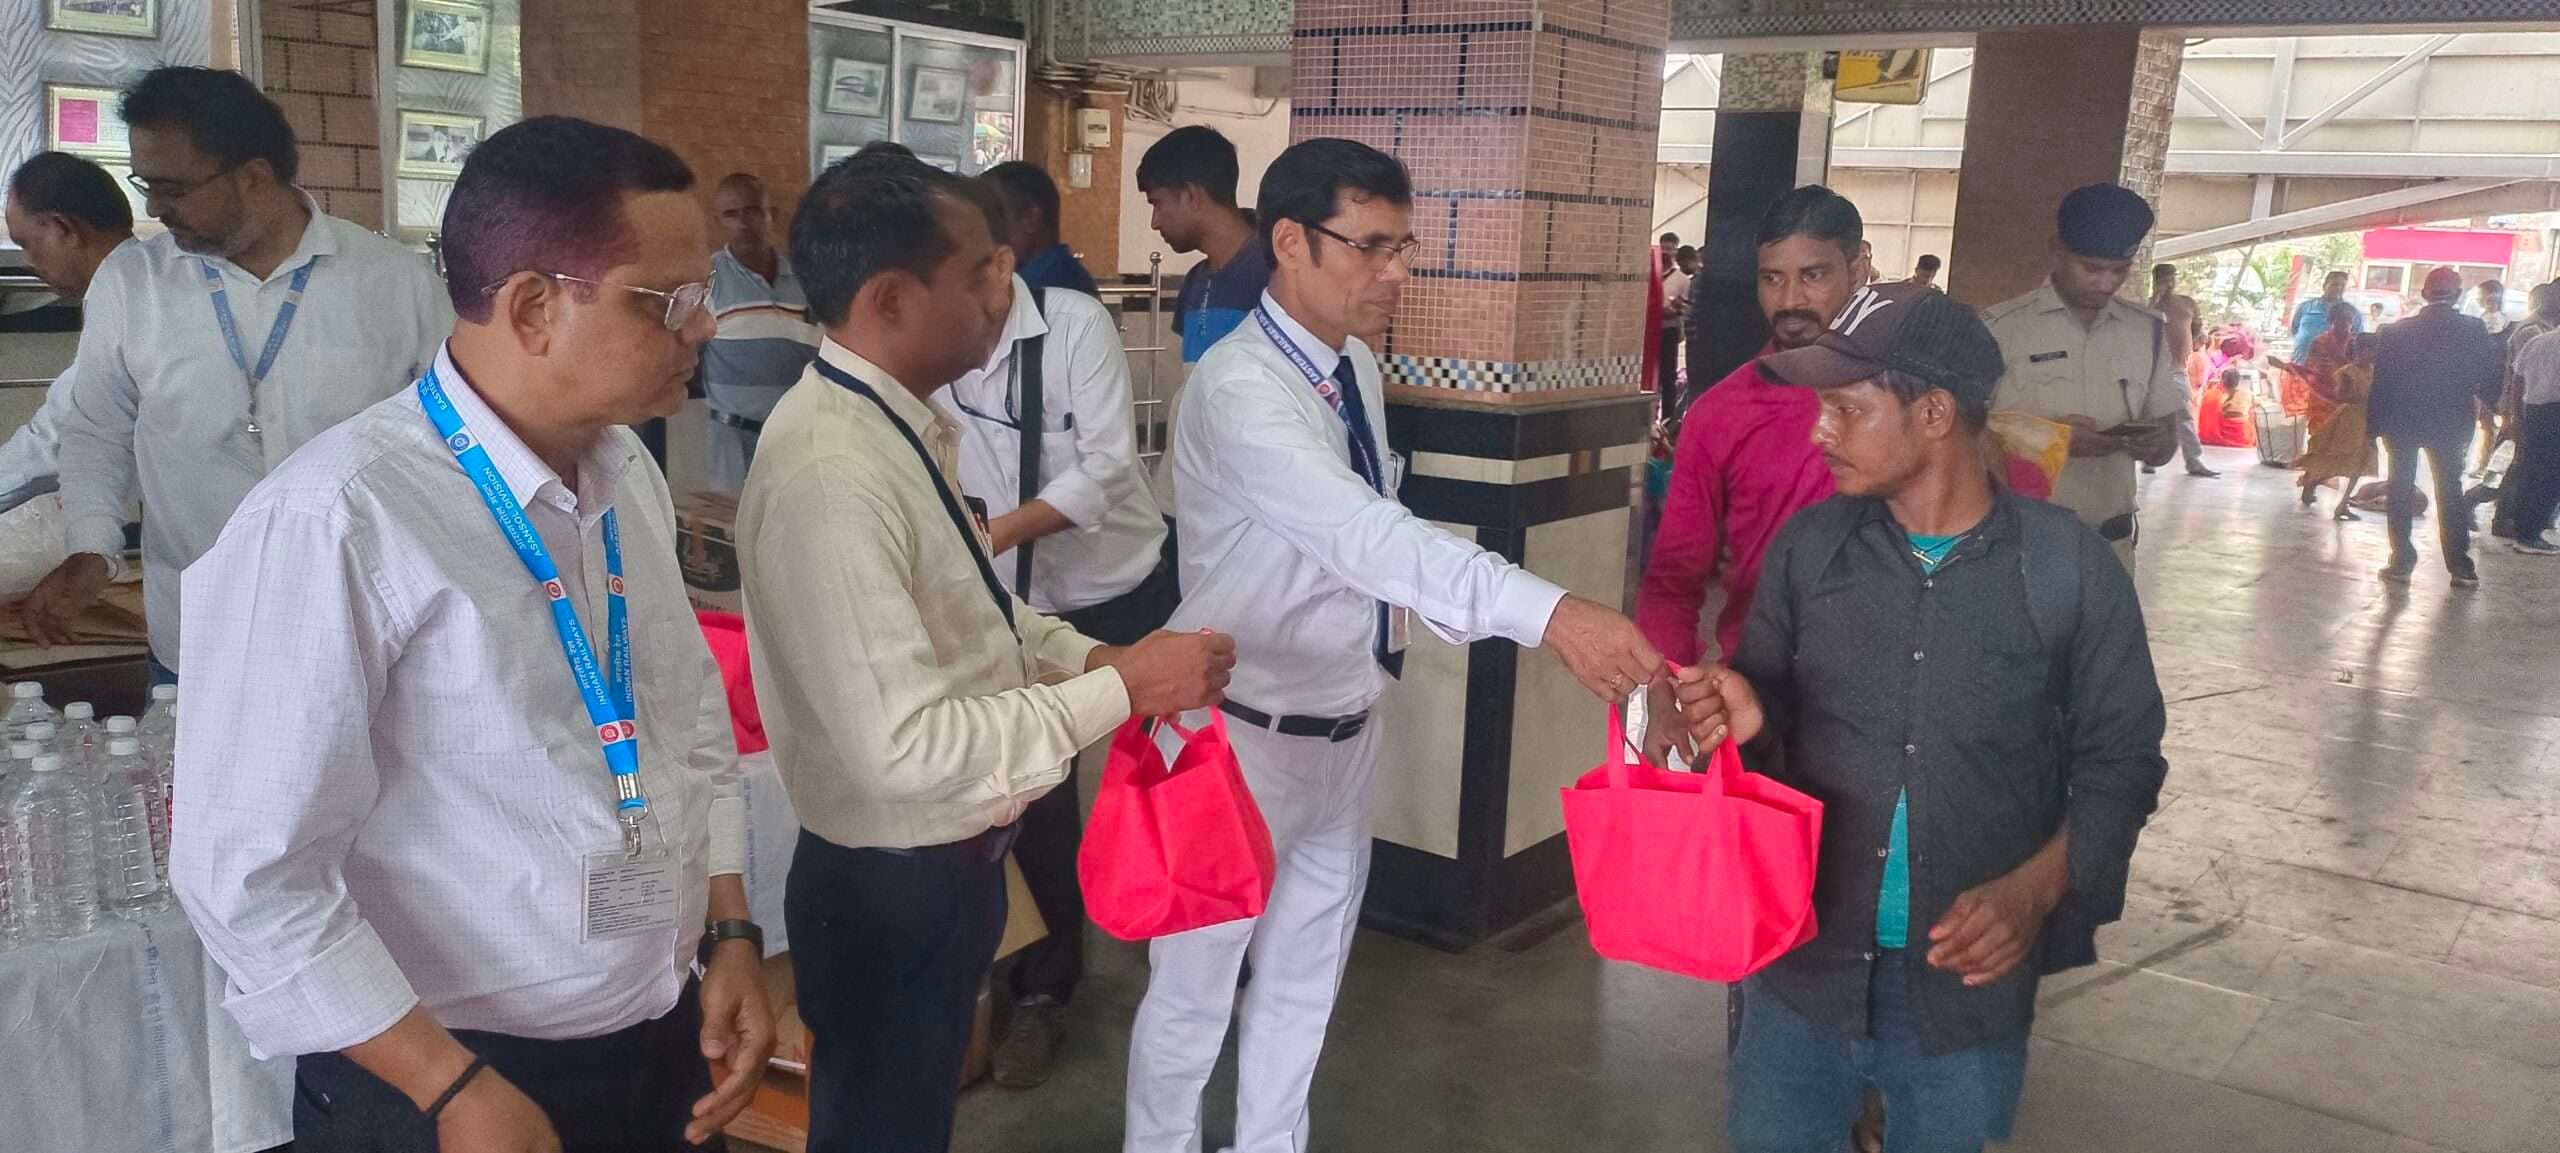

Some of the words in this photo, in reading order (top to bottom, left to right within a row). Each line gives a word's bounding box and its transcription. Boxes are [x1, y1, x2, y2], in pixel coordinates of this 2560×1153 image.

[482, 466, 514, 510] DIVISION
[509, 510, 544, 559] ASANSOL
[567, 618, 593, 670] RAILWAYS
[620, 617, 631, 666] RAILWAYS
[572, 656, 591, 690] भारतीय
[588, 670, 608, 706] INDIAN
[624, 668, 633, 703] INDIAN
